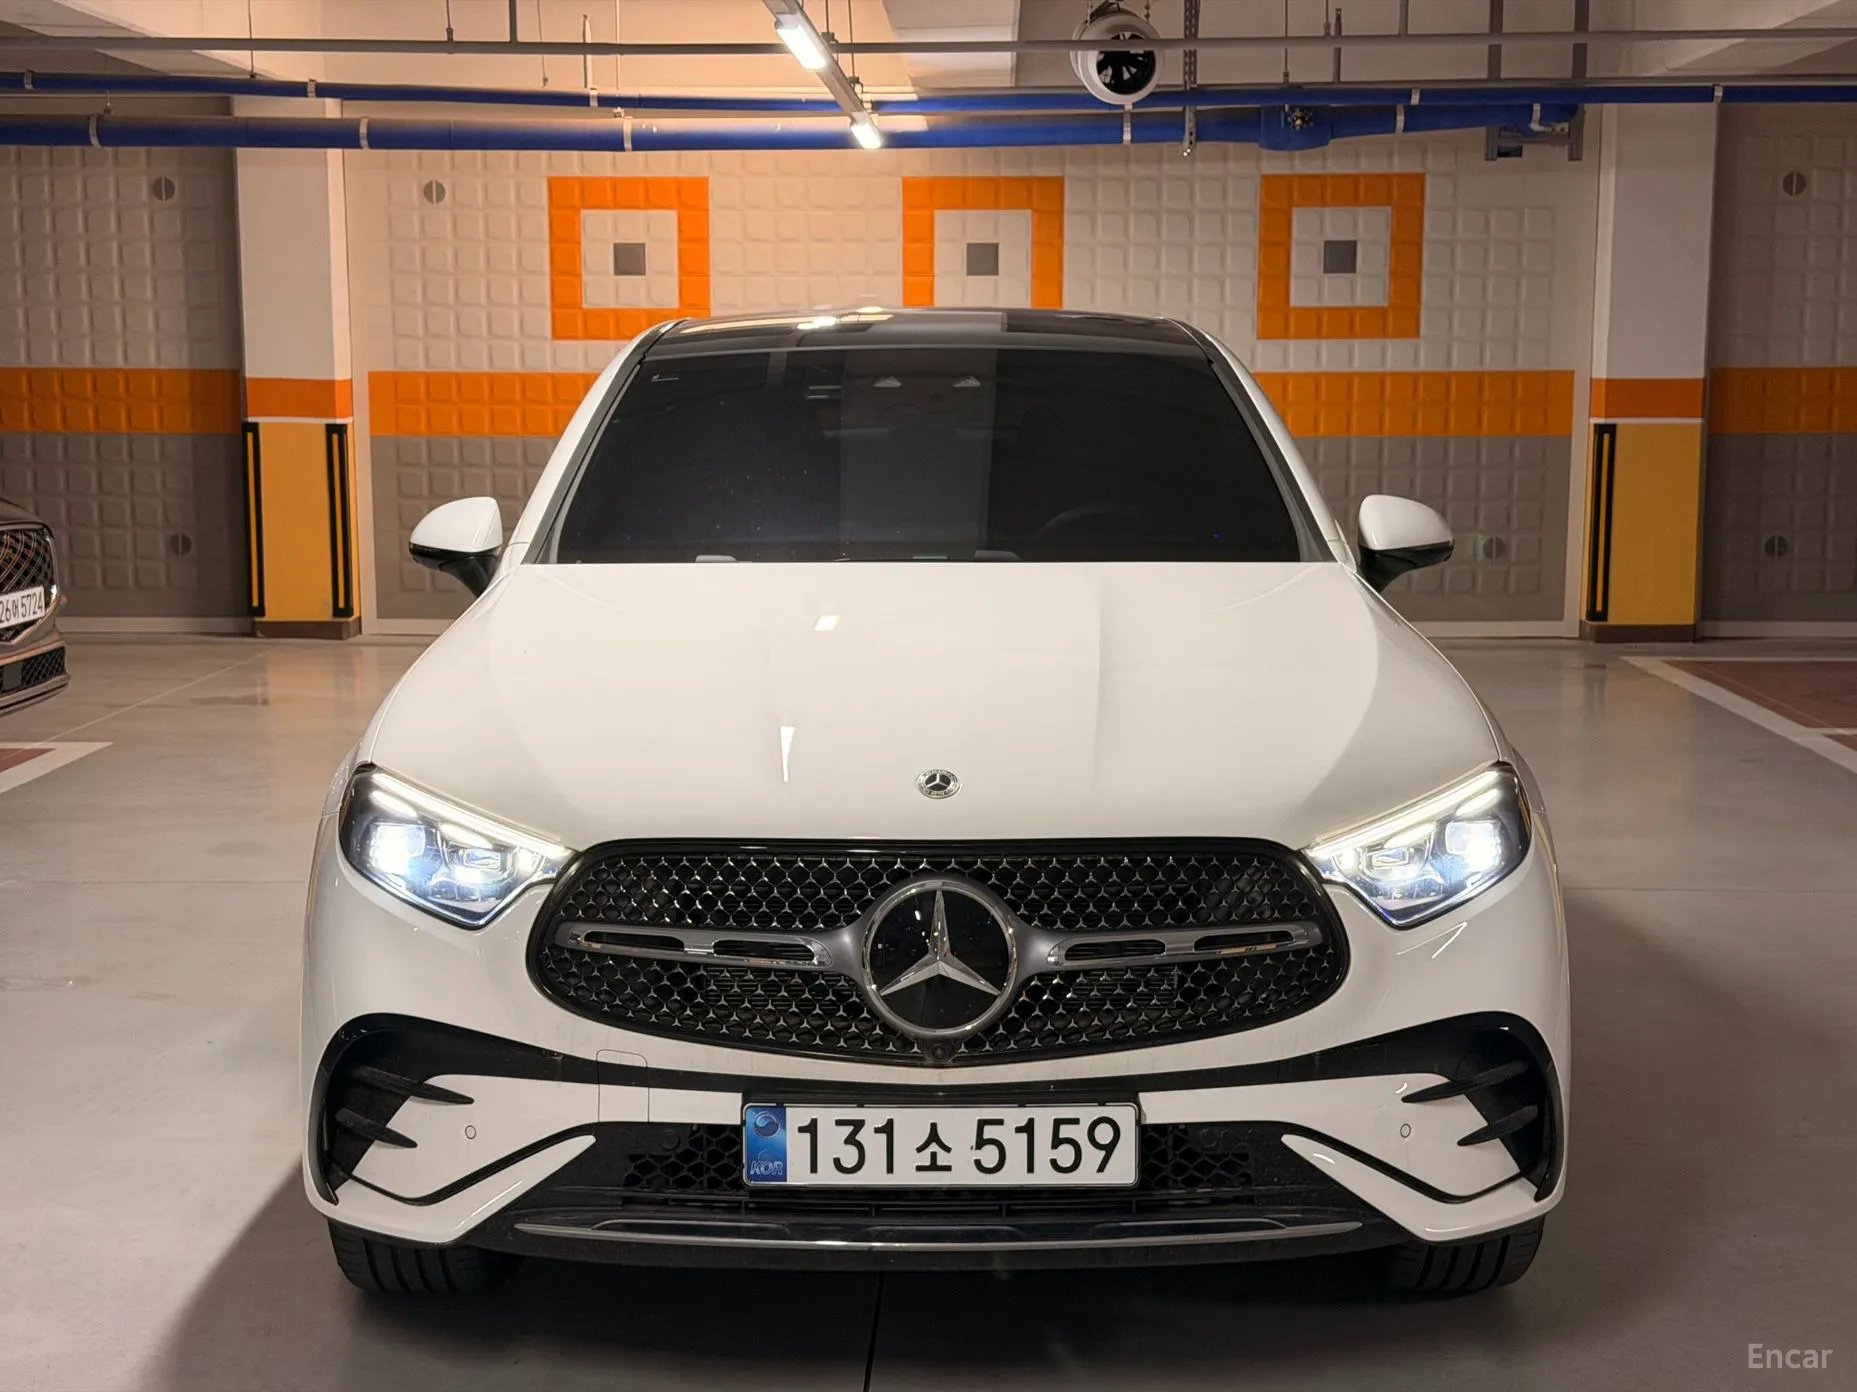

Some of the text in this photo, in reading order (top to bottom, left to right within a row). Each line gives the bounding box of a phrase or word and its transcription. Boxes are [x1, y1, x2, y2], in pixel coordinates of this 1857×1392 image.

[21, 590, 43, 618] 5724
[797, 1116, 1121, 1174] 131소 5159
[750, 1160, 783, 1175] KOR
